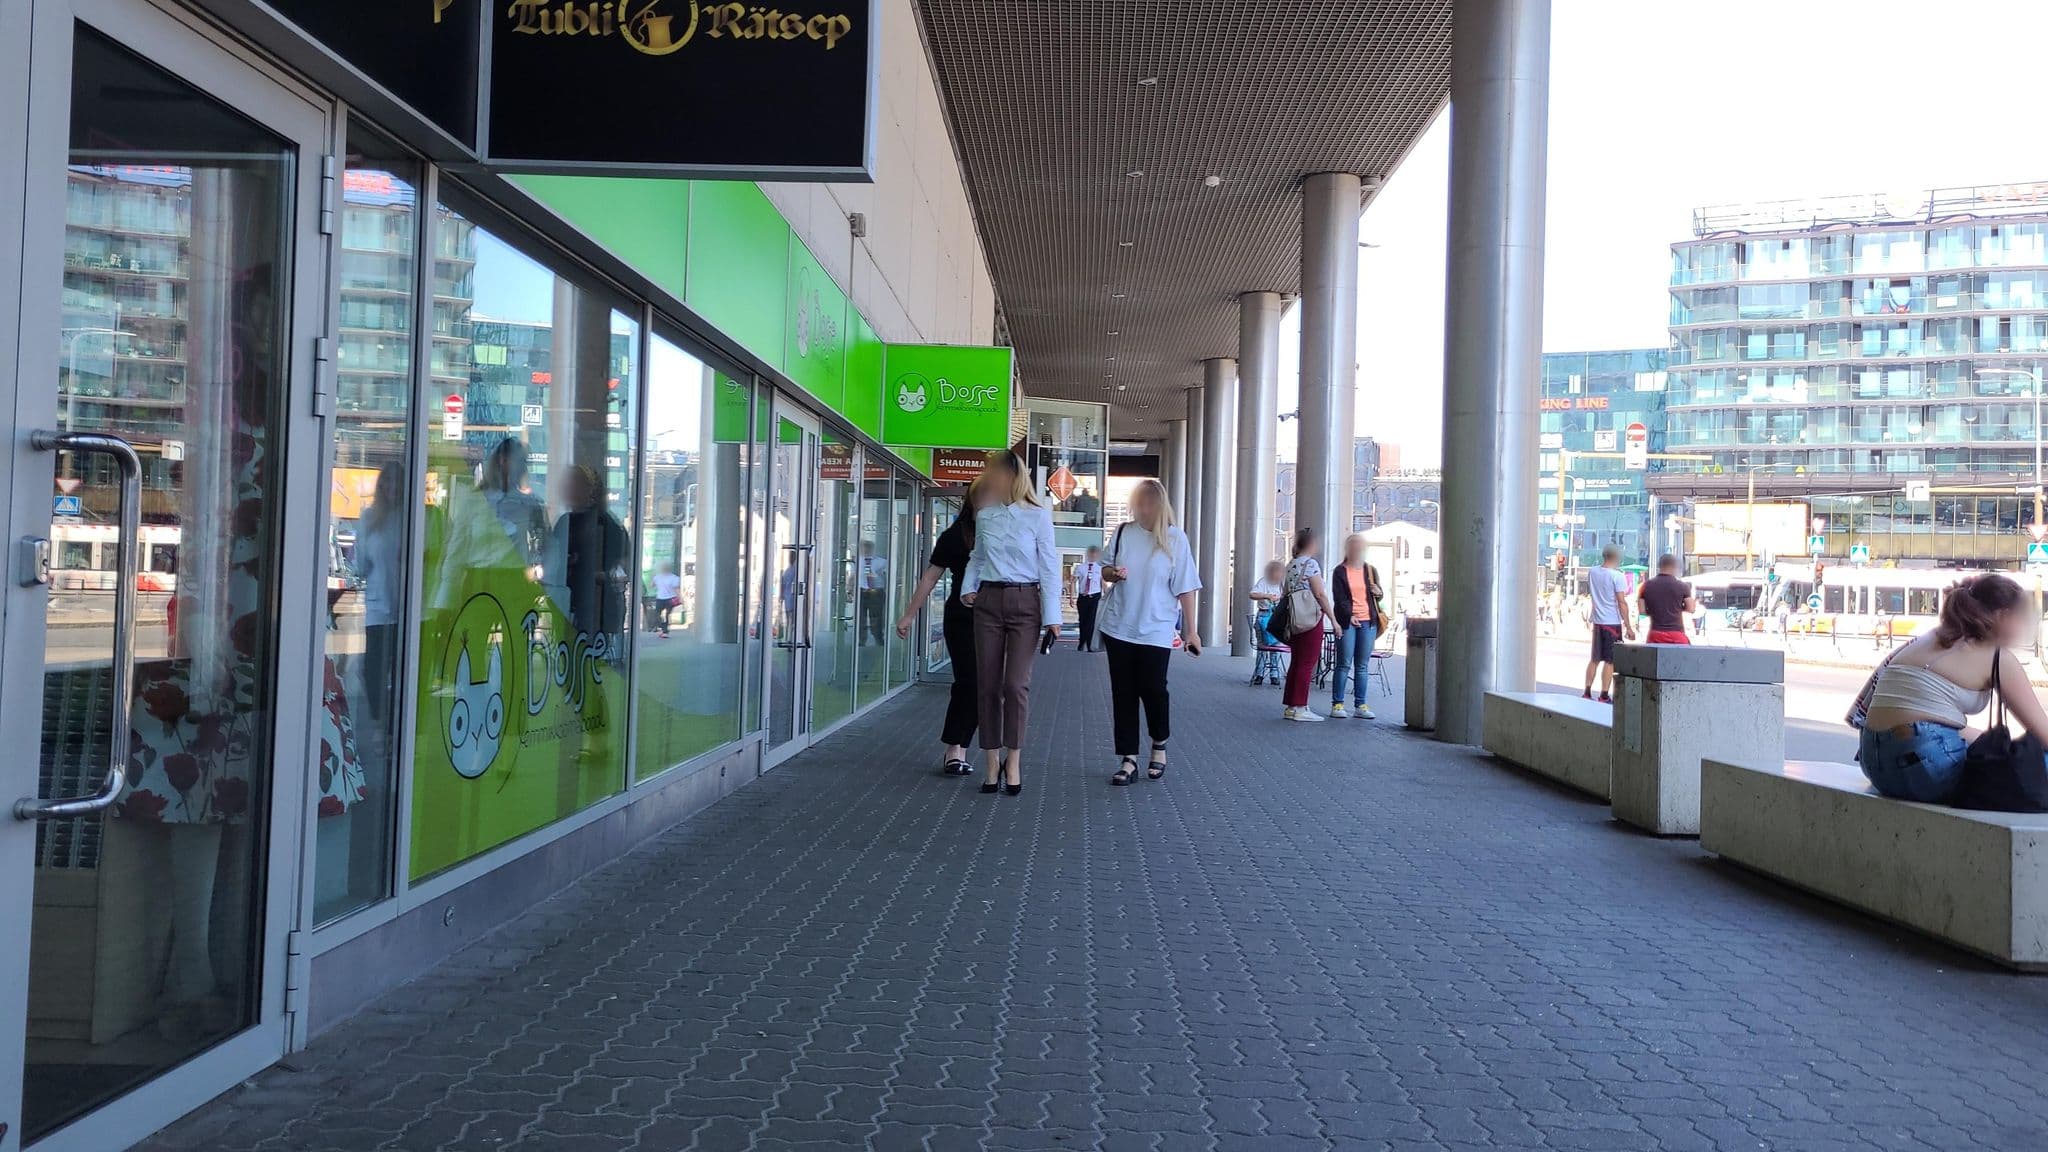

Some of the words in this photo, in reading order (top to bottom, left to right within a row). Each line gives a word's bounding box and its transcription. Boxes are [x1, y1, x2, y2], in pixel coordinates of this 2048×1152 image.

[508, 0, 614, 36] Tubli
[701, 2, 851, 50] Rätsep
[935, 378, 999, 406] Bosse
[1576, 397, 1609, 410] LINE
[939, 458, 986, 469] SHAURMA
[521, 609, 608, 716] Bosse
